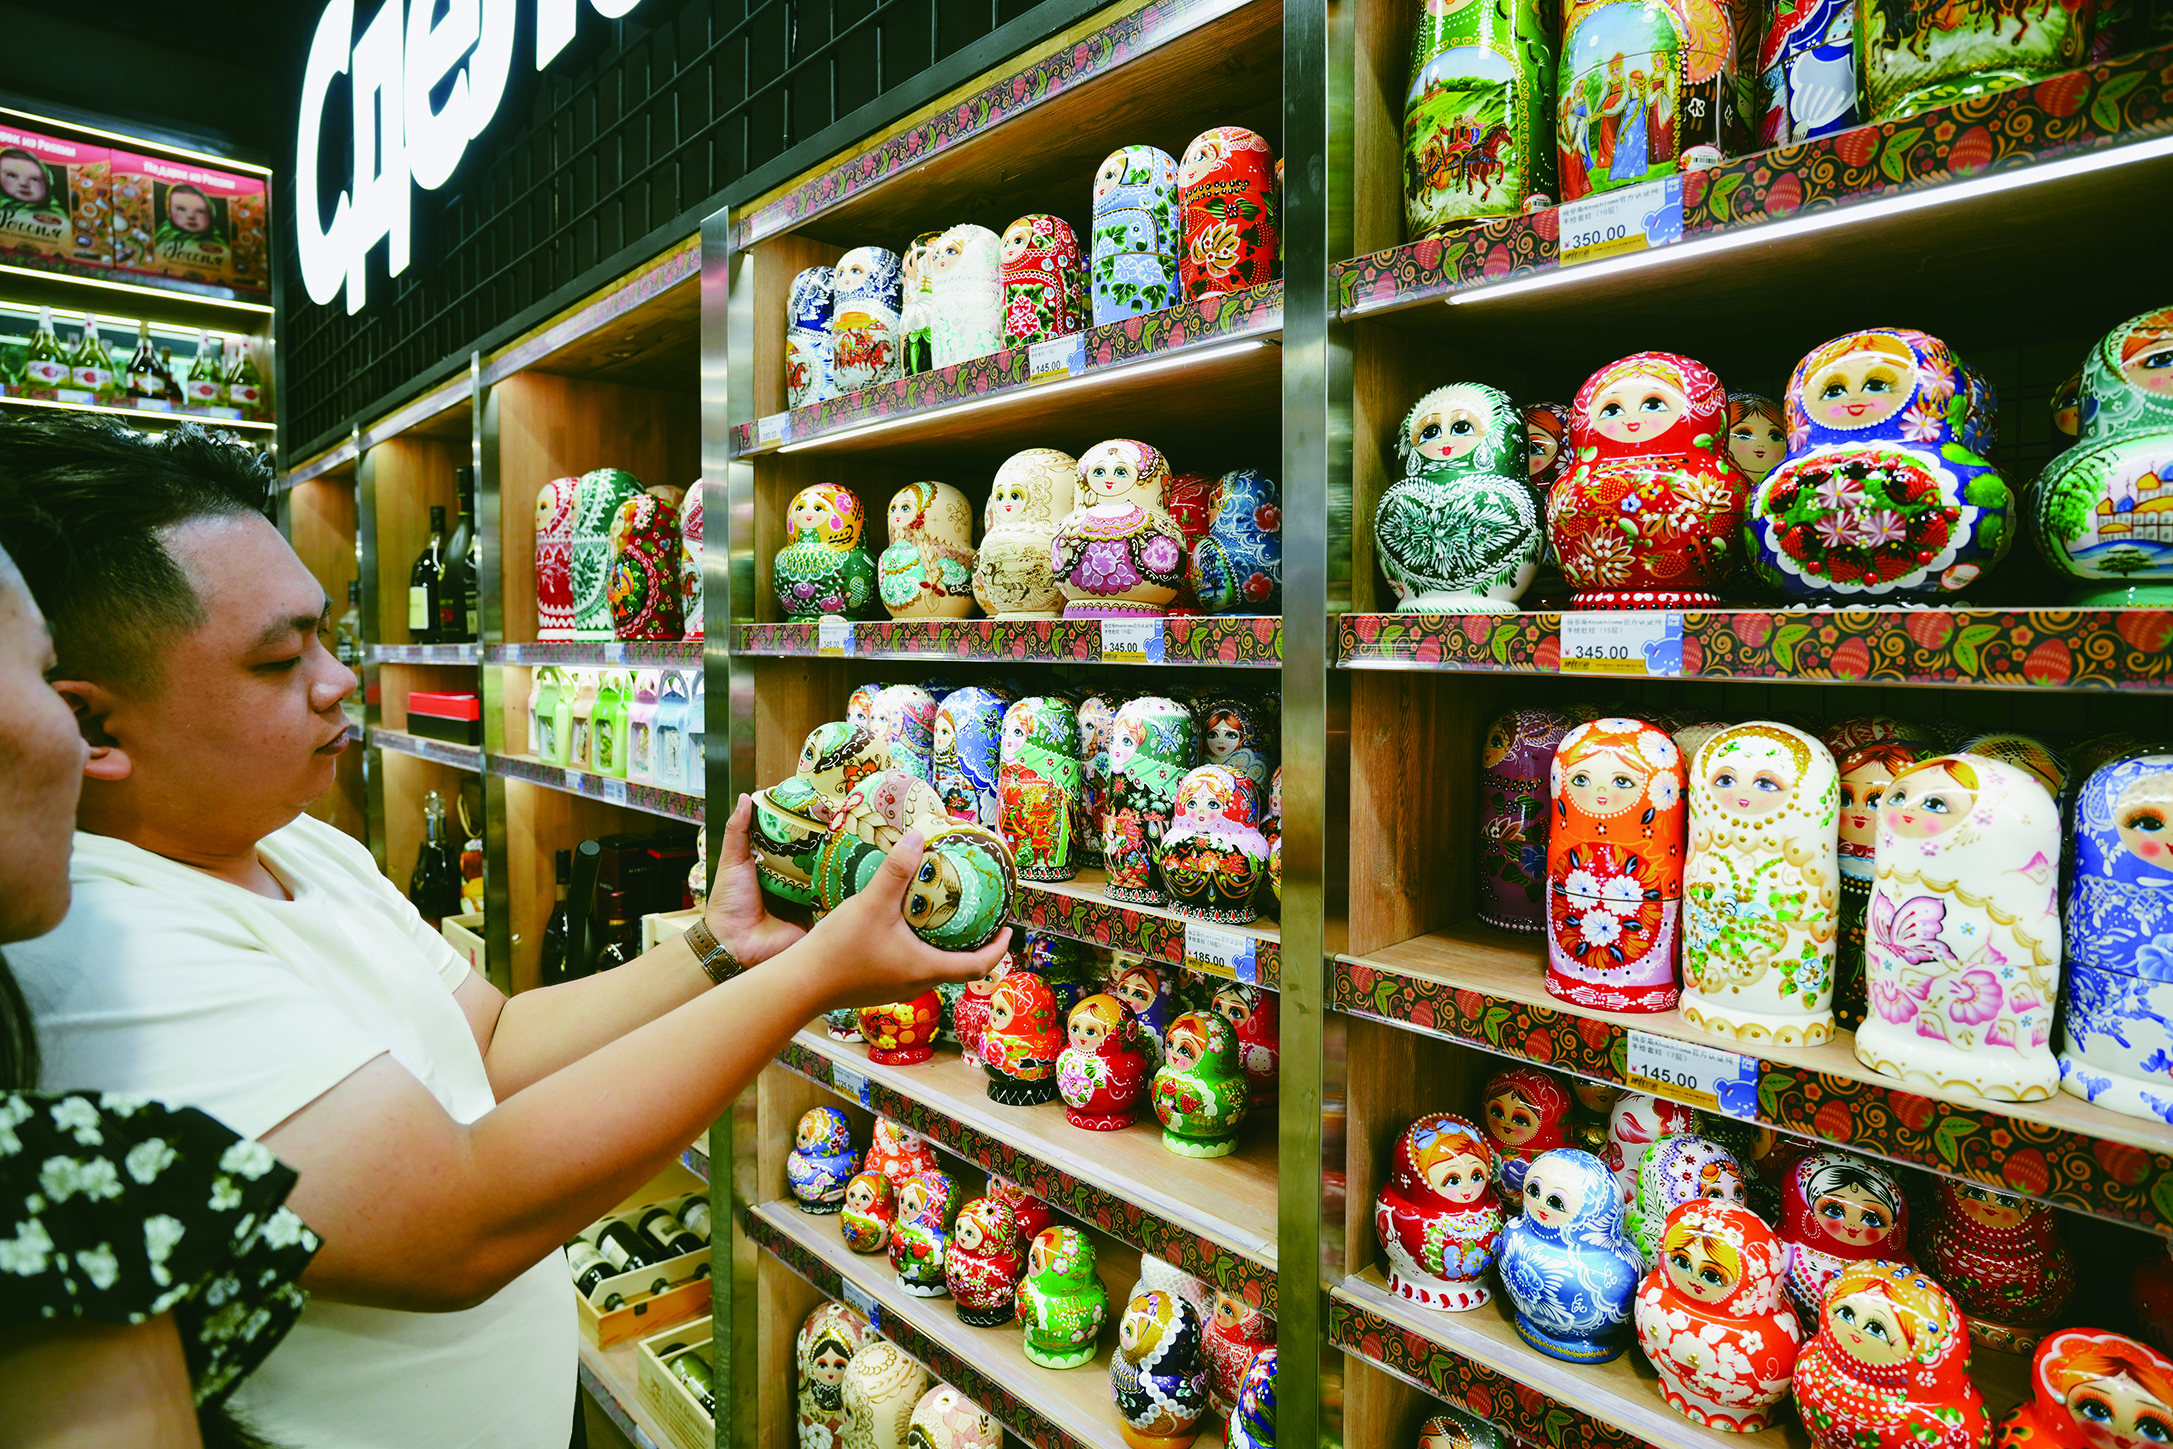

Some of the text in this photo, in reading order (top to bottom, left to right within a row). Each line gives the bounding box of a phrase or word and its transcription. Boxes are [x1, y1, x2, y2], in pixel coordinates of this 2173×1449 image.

[1572, 224, 1626, 249] 350.00
[1036, 360, 1061, 374] 145.00
[1109, 642, 1138, 653] 345.00
[1575, 646, 1629, 660] 345.00
[1193, 951, 1225, 968] 185.00
[1640, 1064, 1698, 1090] 145.00
